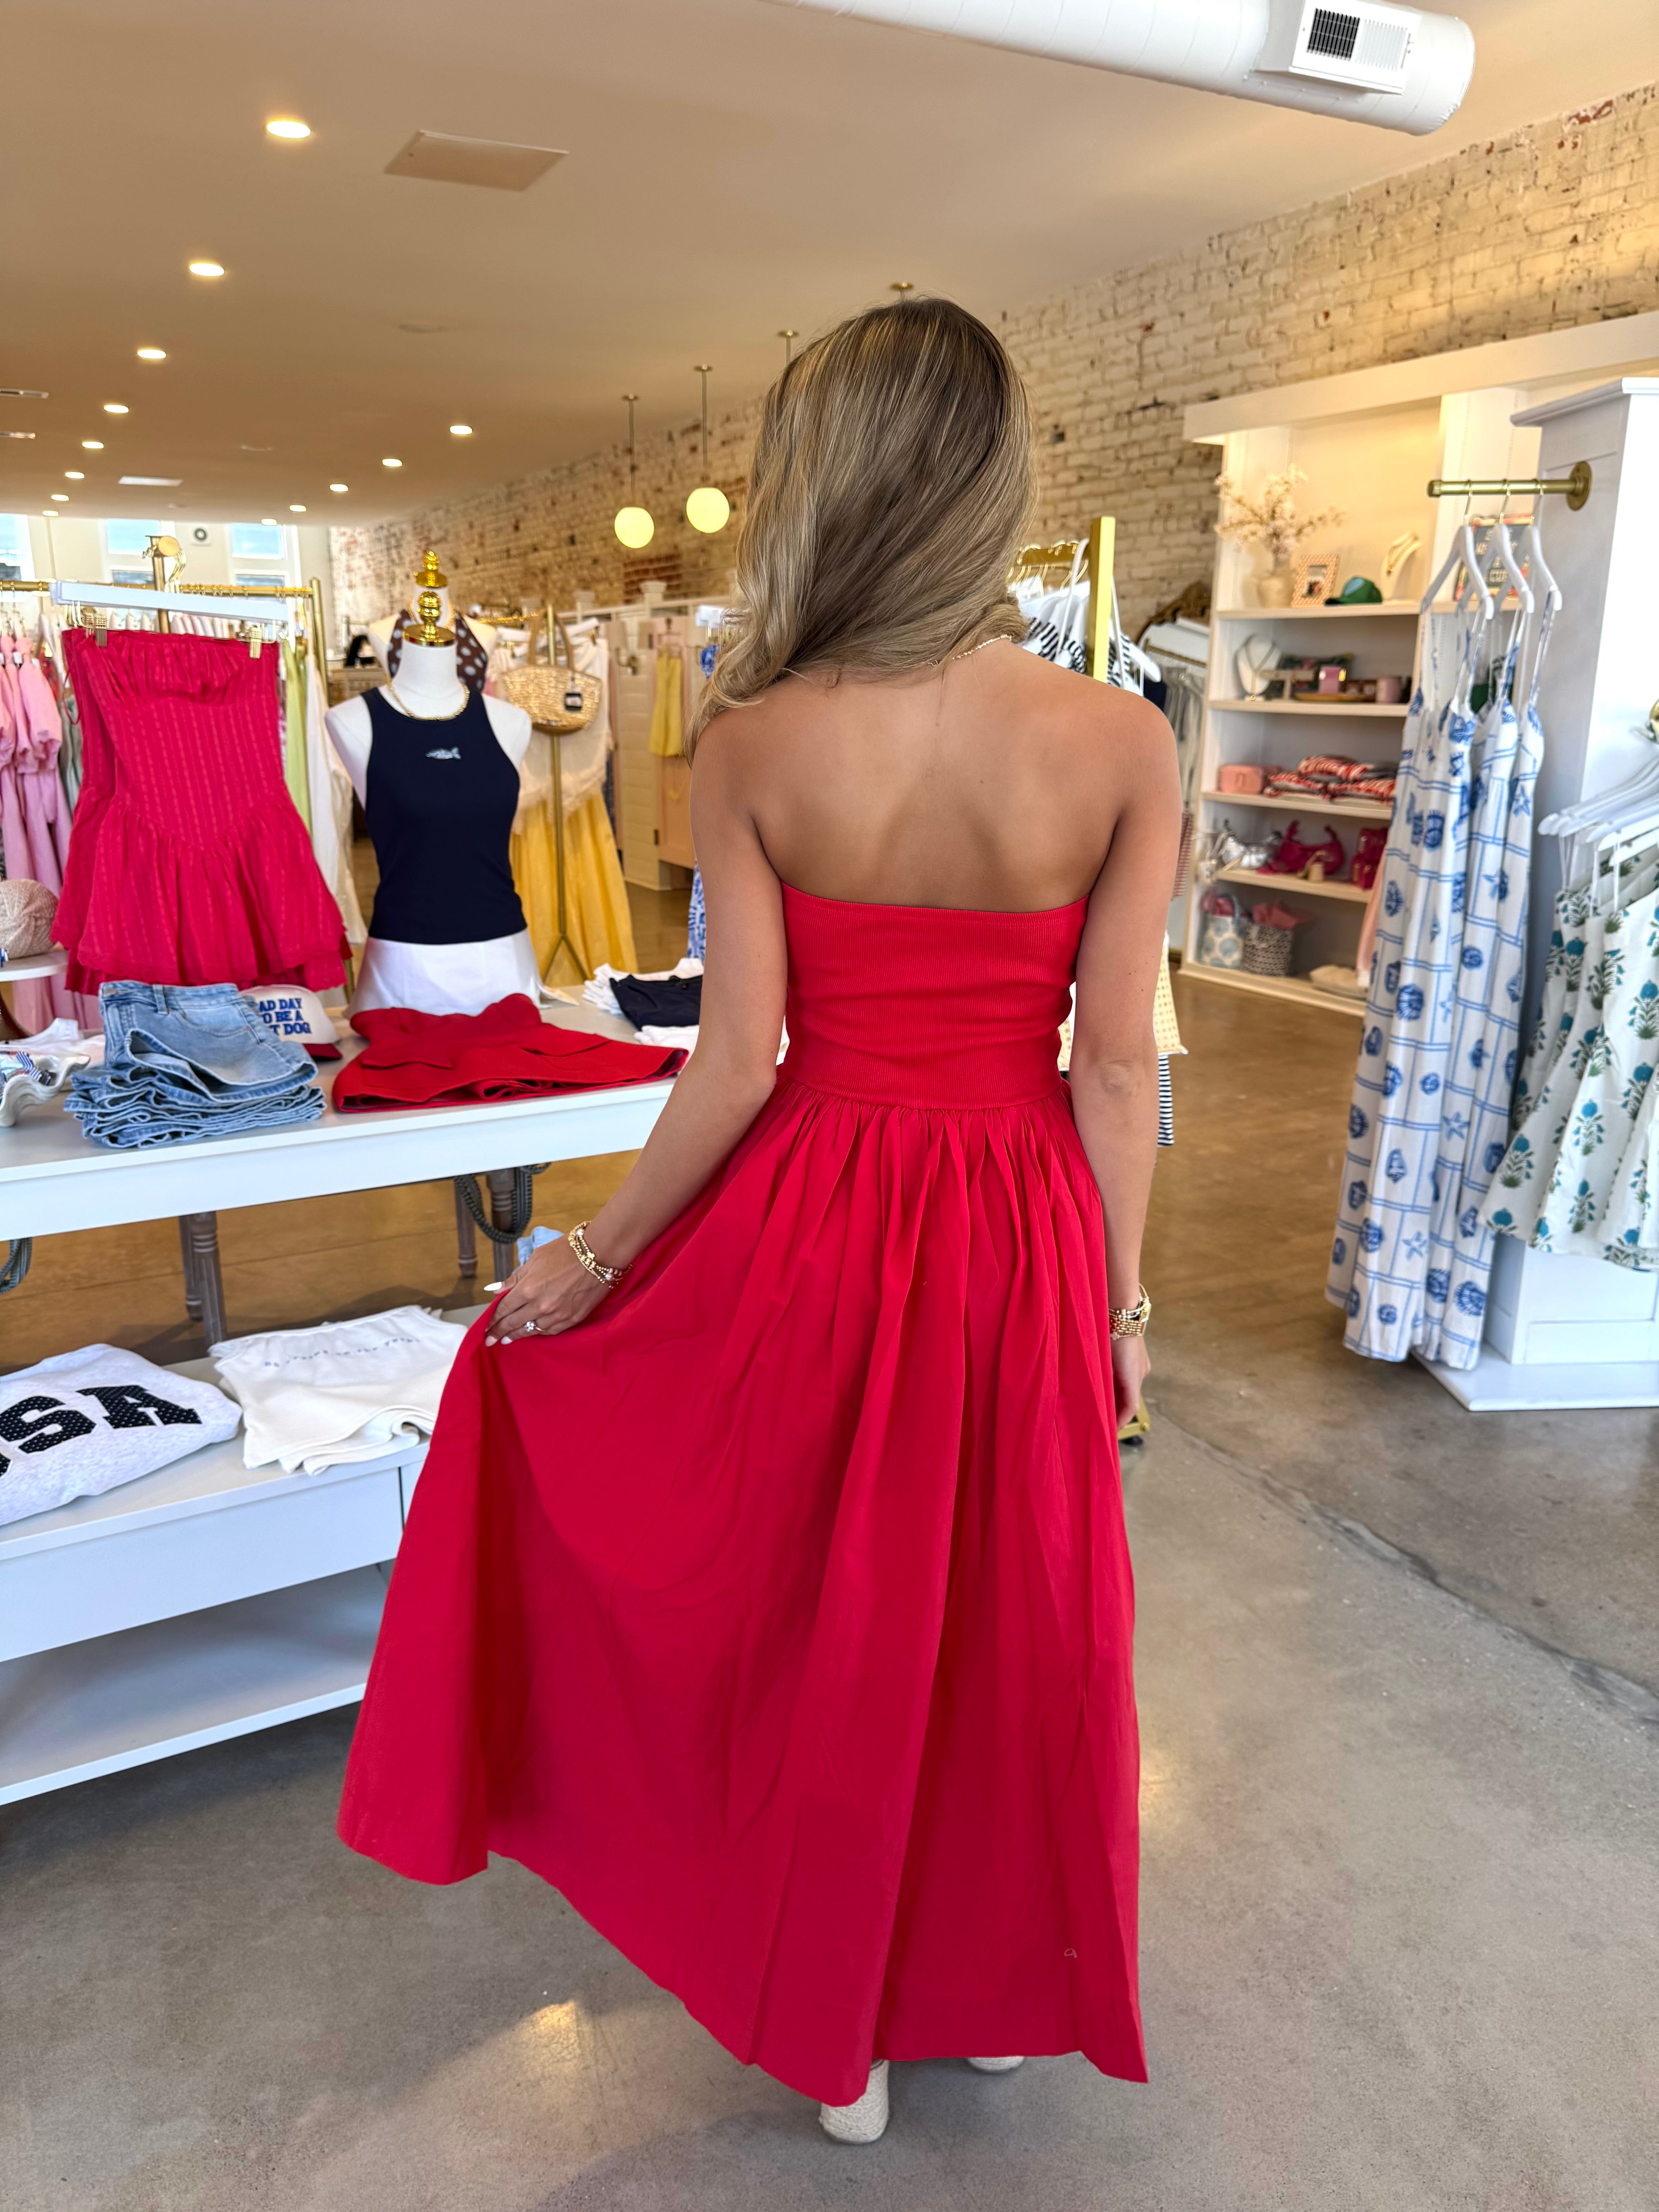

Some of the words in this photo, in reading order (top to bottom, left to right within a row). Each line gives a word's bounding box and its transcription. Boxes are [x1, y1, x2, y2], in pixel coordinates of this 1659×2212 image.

[259, 1000, 276, 1012] AD
[278, 998, 302, 1009] DAY
[262, 1013, 272, 1024] O
[275, 1011, 292, 1022] BE
[295, 1010, 304, 1021] A
[283, 1022, 312, 1035] DOG
[0, 1385, 203, 1477] SA
